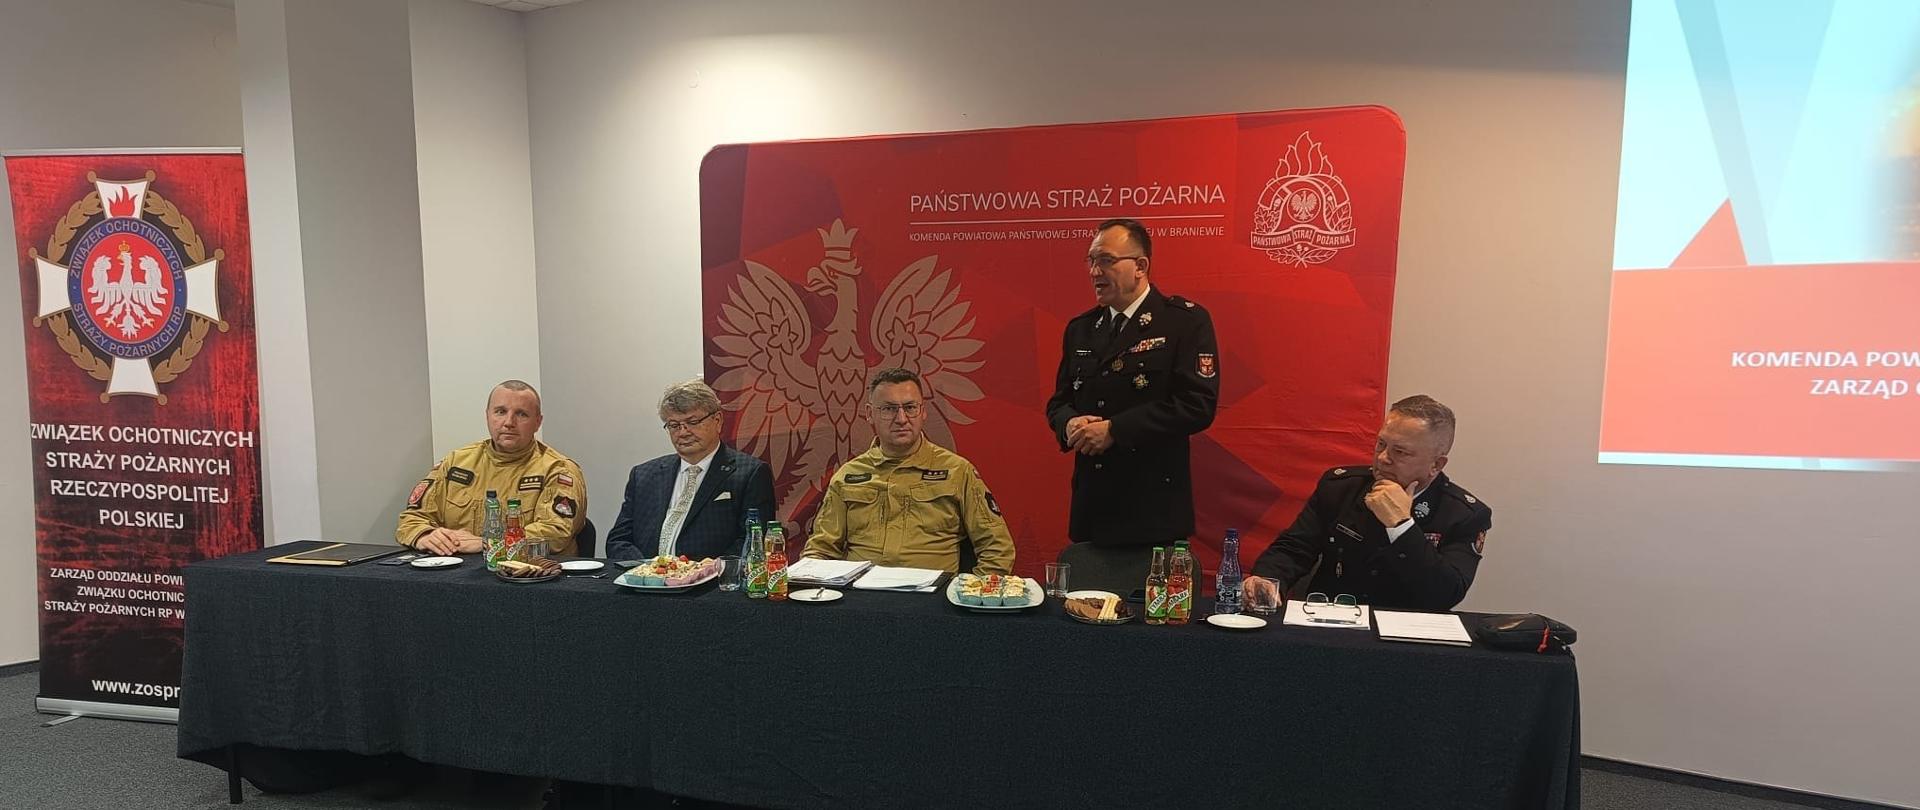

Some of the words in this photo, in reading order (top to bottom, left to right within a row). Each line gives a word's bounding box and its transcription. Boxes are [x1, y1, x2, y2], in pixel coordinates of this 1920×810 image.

[910, 189, 1042, 212] PAŃSTWOWA
[1047, 184, 1113, 208] STRAŻ
[1119, 181, 1226, 206] POŻARNA
[909, 232, 951, 242] KOMENDA
[953, 230, 1007, 241] POWIATOWA
[1008, 227, 1070, 240] PAŃSTWOWEJ
[1156, 227, 1168, 237] W
[1170, 226, 1225, 237] BRANIEWIE
[70, 228, 105, 279] ZWIĄZEK
[105, 219, 183, 280] OCHOTNICZYCH
[108, 324, 175, 357] POŻARNYCH
[171, 305, 183, 326] RP
[1731, 351, 1859, 368] KOMENDA
[1809, 378, 1909, 400] ZARZĄD
[30, 422, 105, 445] ZWIĄZEK
[108, 425, 253, 448] OCHOTNICZYCH
[46, 449, 116, 471] STRAŻY
[120, 451, 231, 476] POŻARNYCH
[50, 479, 229, 505] RZECZYPOSPOLITEJ
[99, 508, 185, 530] POLSKIEJ
[50, 567, 95, 583] ZARZĄD
[97, 570, 151, 585] ODDZIAŁU
[154, 573, 185, 587] POWI
[77, 585, 126, 600] ZWIĄZKU
[128, 588, 185, 603] OCHOTNIC
[44, 600, 86, 613] STRAŻY
[88, 602, 156, 618] POŻARNYCH
[158, 607, 172, 618] RP
[174, 608, 185, 620] W
[91, 678, 181, 701] www.zospr
